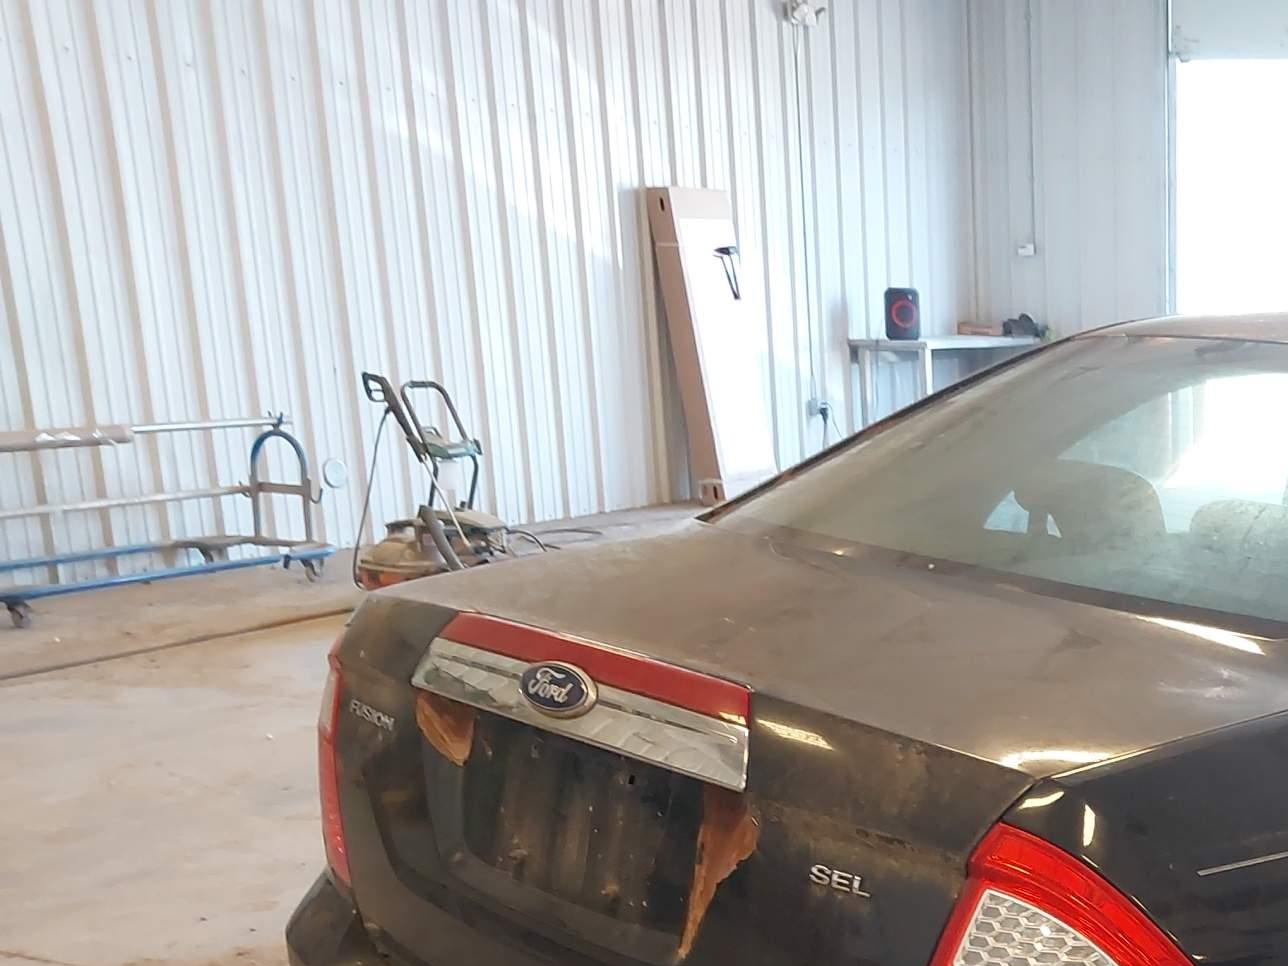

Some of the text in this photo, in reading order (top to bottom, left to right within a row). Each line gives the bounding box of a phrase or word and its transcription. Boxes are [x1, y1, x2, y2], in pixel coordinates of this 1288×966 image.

[528, 667, 574, 703] Ford
[351, 699, 395, 731] FUSION
[809, 864, 871, 898] SEL
